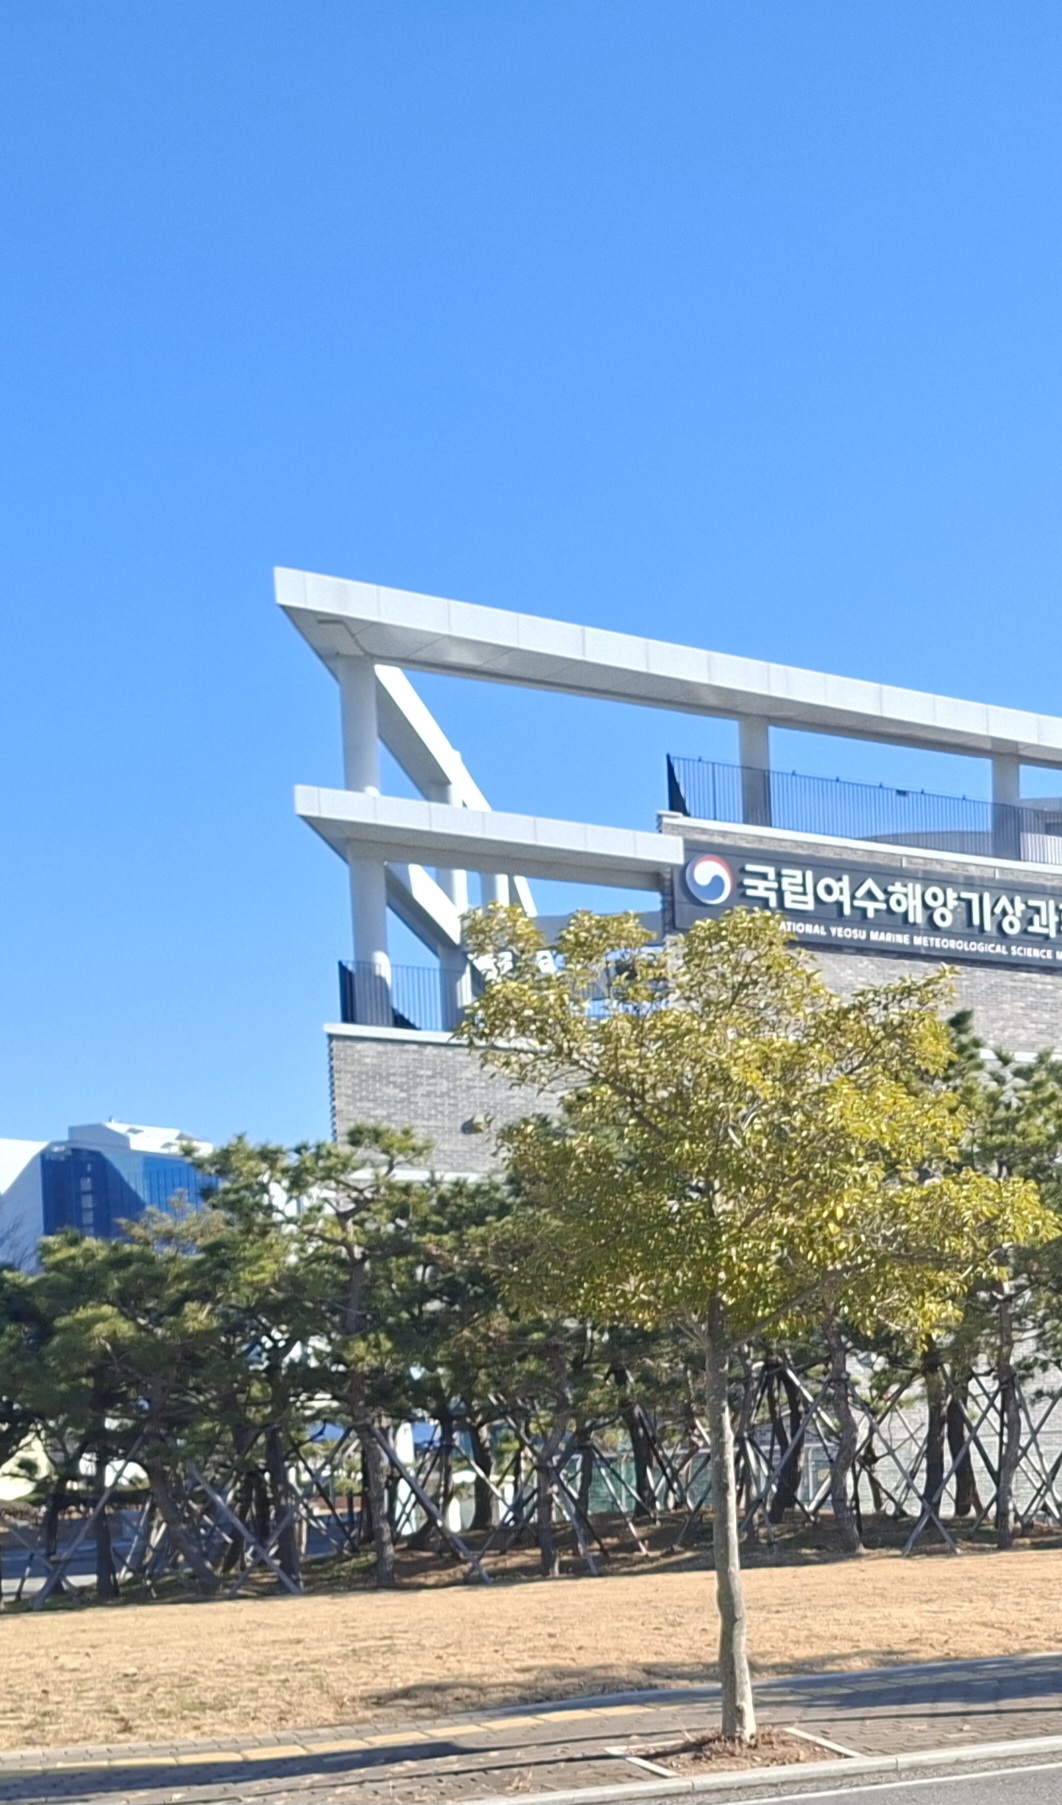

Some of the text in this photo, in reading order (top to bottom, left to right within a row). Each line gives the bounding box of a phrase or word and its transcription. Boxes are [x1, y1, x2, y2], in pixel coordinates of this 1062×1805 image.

[778, 920, 827, 936] ATIONAL
[829, 926, 866, 940] YEOSU
[869, 930, 910, 945] MARINE
[912, 935, 1008, 956] METEOROLOGICAL
[1010, 945, 1053, 960] SCIENCE
